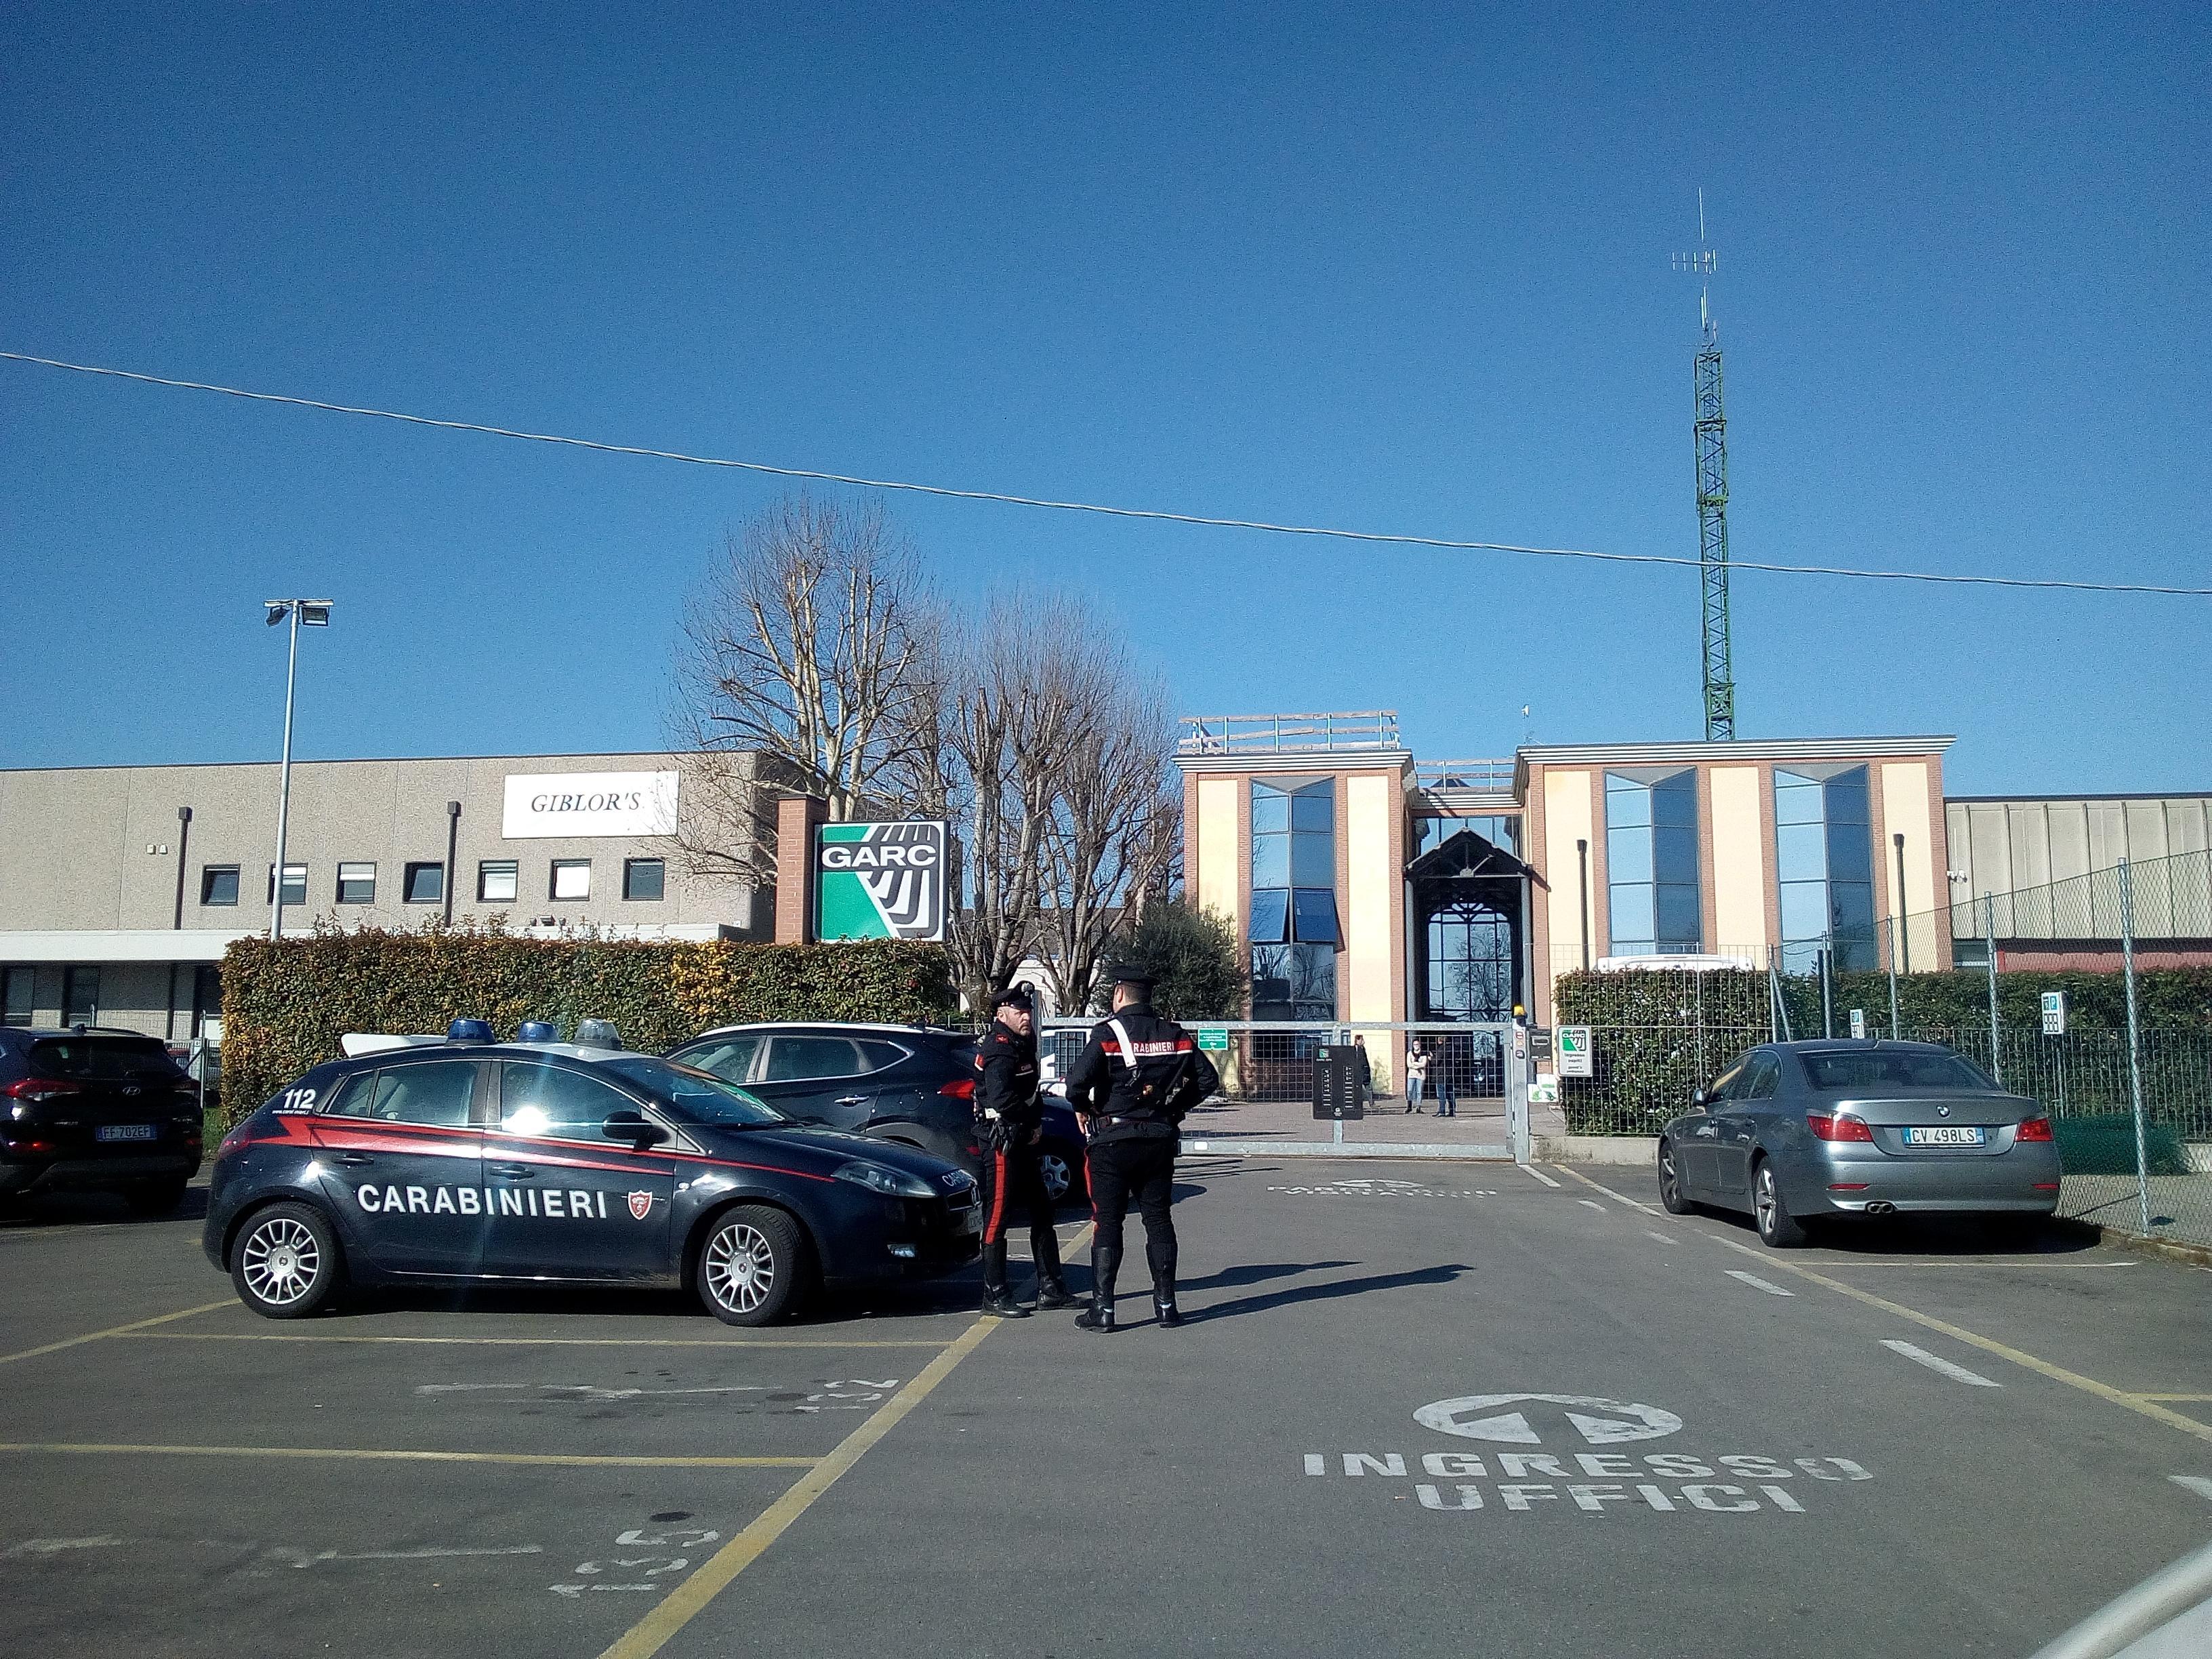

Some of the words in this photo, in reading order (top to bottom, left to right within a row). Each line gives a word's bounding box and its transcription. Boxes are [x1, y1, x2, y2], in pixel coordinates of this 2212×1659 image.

[531, 792, 641, 813] GIBLOR'S
[822, 844, 937, 868] GARC
[1130, 1042, 1174, 1052] RABINIERI
[283, 1088, 316, 1109] 112
[104, 1126, 115, 1139] FF
[119, 1126, 150, 1138] 702EF
[1912, 1129, 1927, 1142] CV
[1934, 1129, 1975, 1142] 498LS
[357, 1184, 608, 1218] CARABINIERI
[1303, 1453, 1873, 1481] INGRESSO
[1414, 1484, 1806, 1512] UFFICI
